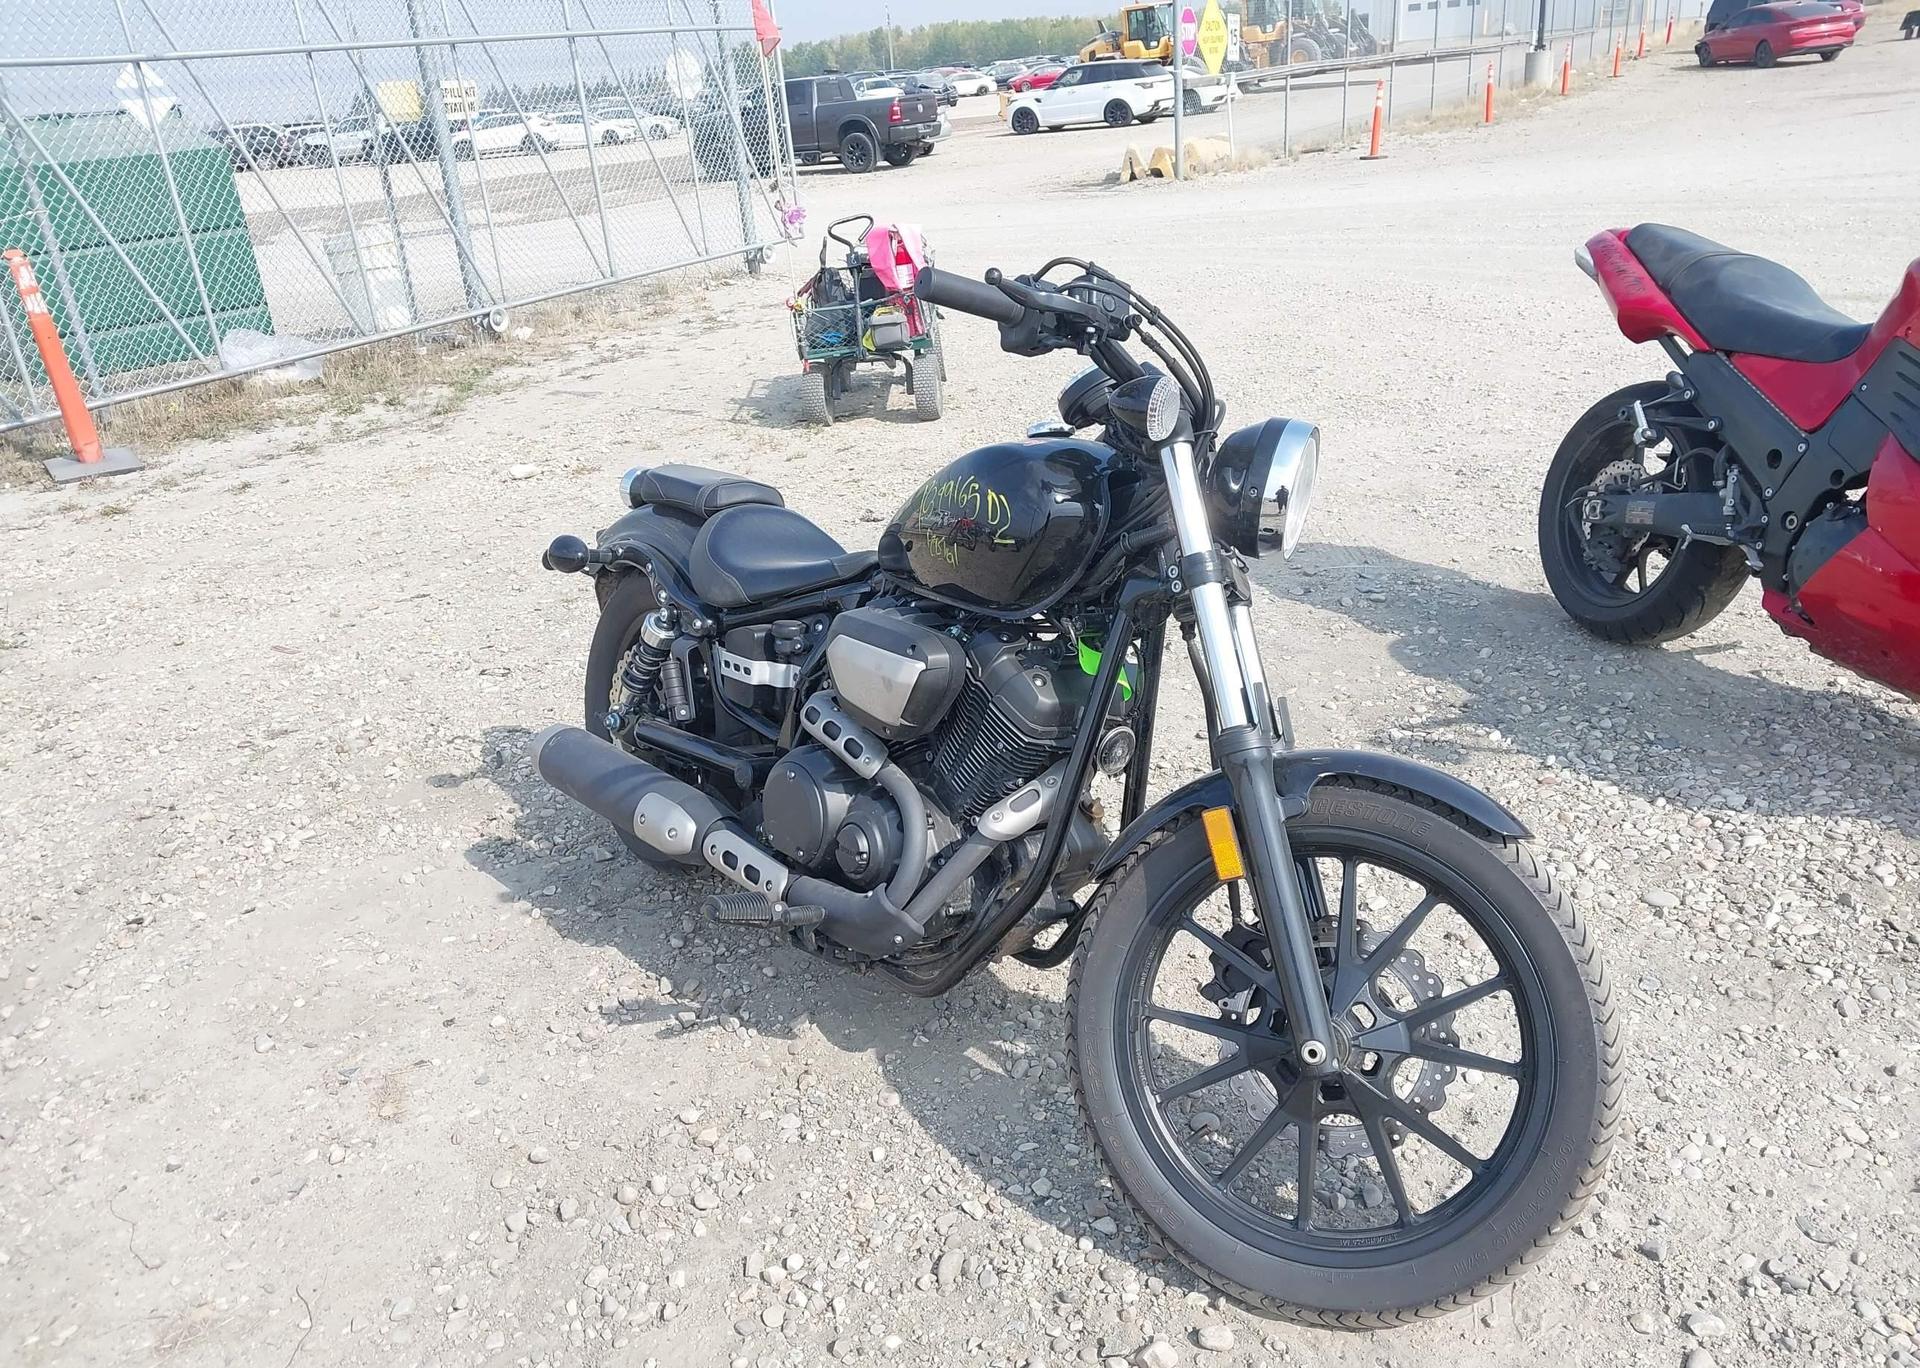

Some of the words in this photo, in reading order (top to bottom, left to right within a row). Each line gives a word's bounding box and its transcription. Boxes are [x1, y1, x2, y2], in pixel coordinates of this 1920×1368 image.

[1181, 24, 1196, 40] STOP
[1230, 28, 1238, 46] 15
[441, 87, 462, 98] SPILL
